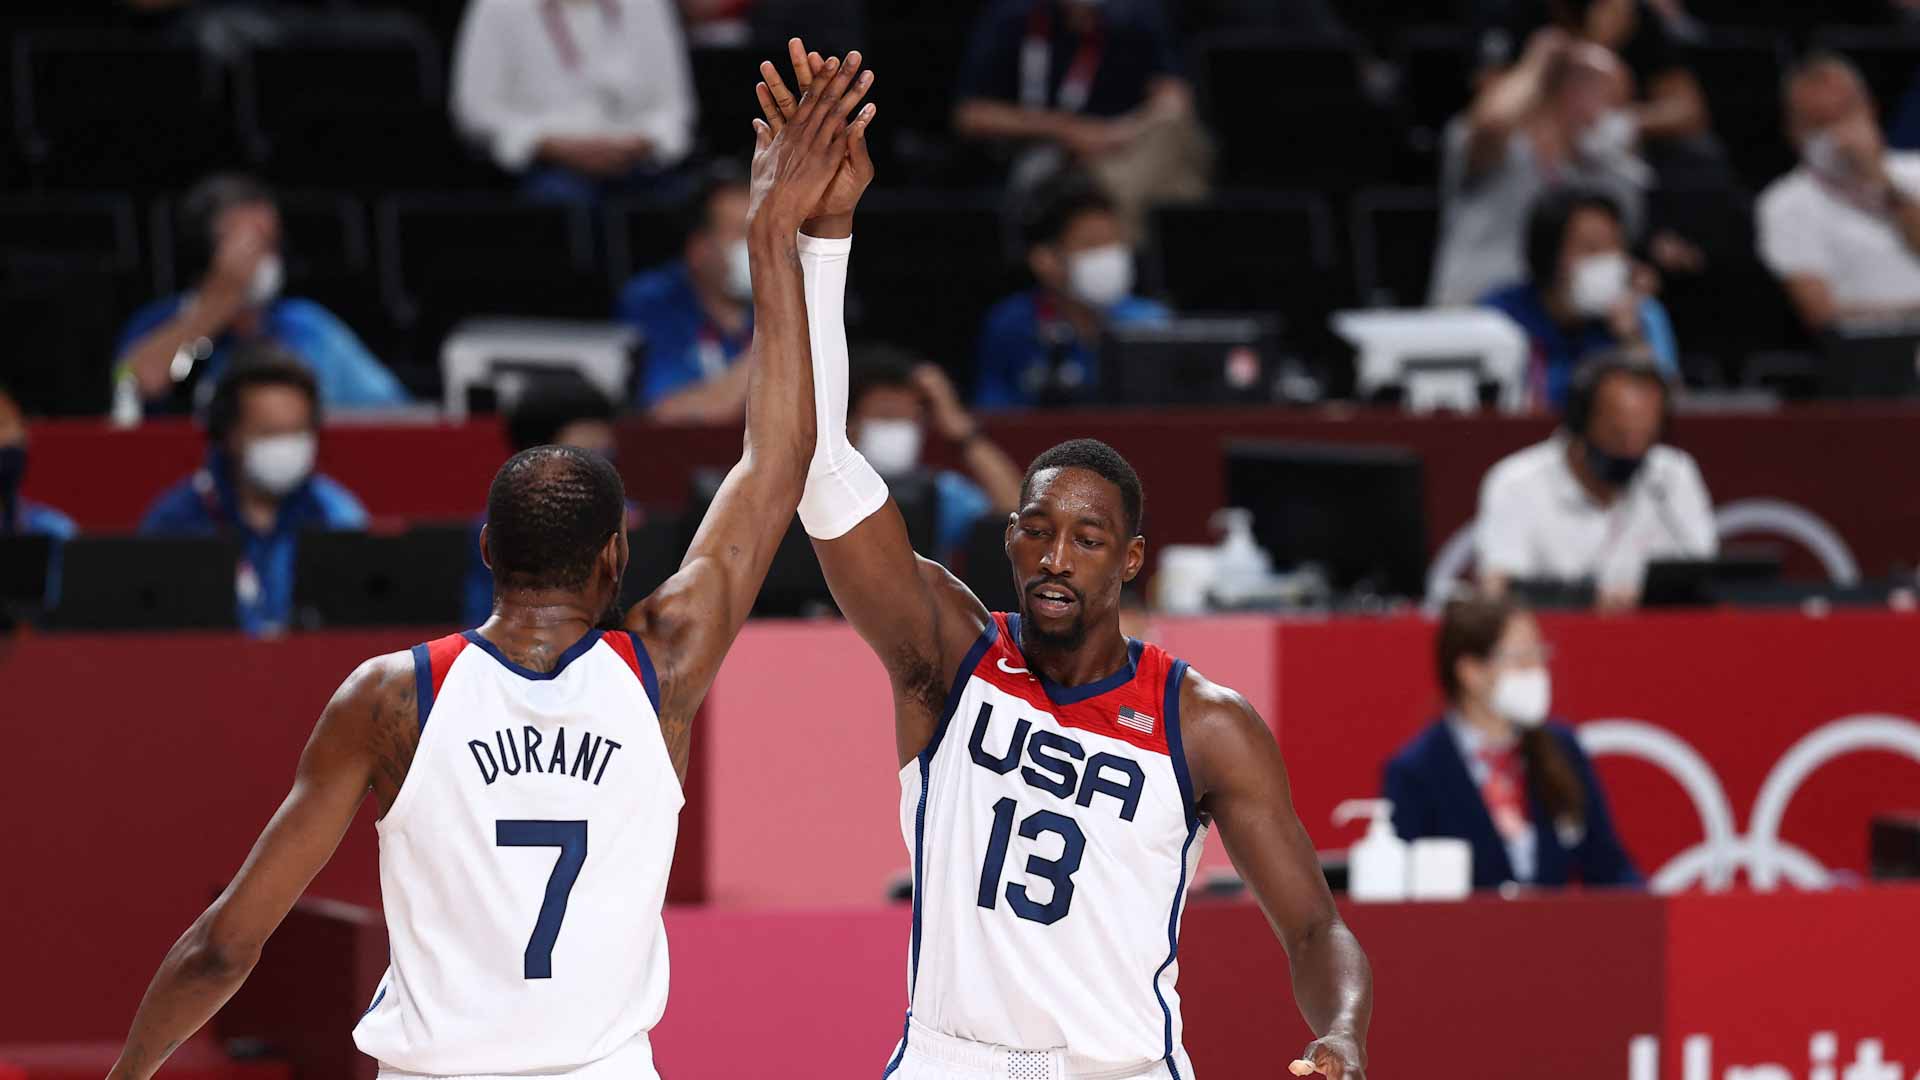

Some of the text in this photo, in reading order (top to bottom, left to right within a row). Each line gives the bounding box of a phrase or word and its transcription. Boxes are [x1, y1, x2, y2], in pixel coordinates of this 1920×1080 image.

[467, 725, 622, 785] DURANT
[967, 701, 1146, 823] USA
[495, 819, 588, 979] 7
[976, 796, 1087, 926] 13
